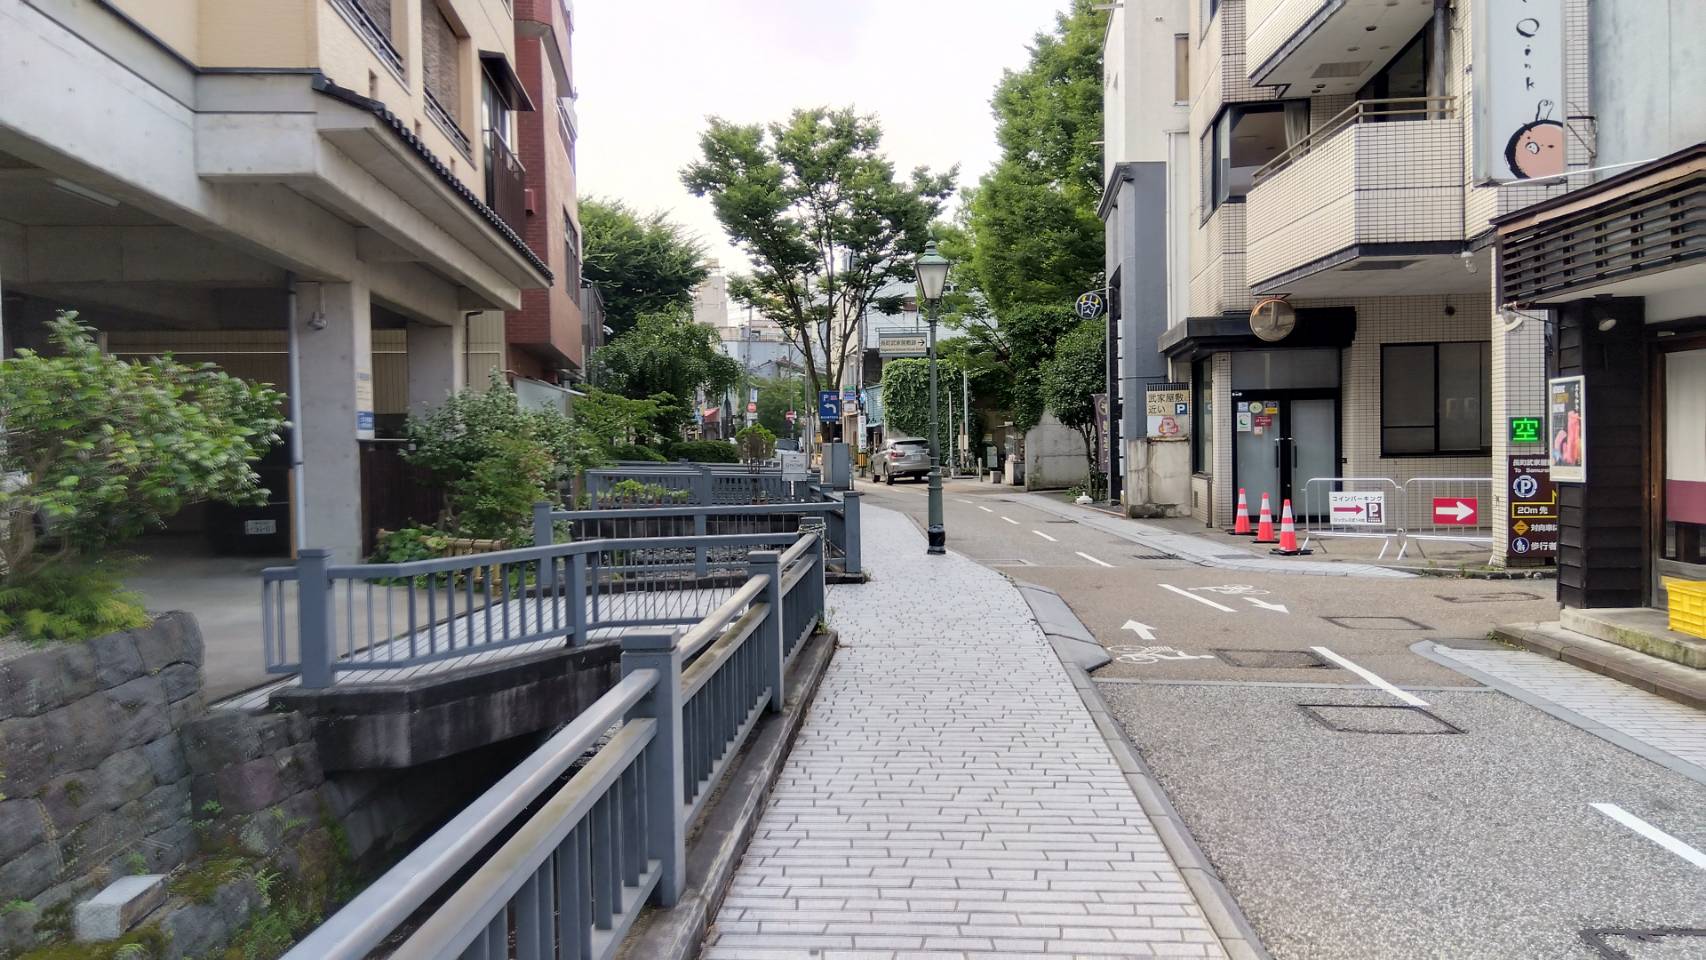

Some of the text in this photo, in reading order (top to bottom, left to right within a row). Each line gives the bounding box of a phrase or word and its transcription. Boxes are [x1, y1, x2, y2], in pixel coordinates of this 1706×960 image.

[1148, 392, 1184, 403] 武家屋敷
[1148, 404, 1166, 414] 近い
[1176, 404, 1186, 414] P
[1512, 417, 1538, 441] 空
[1539, 505, 1549, 515] 先
